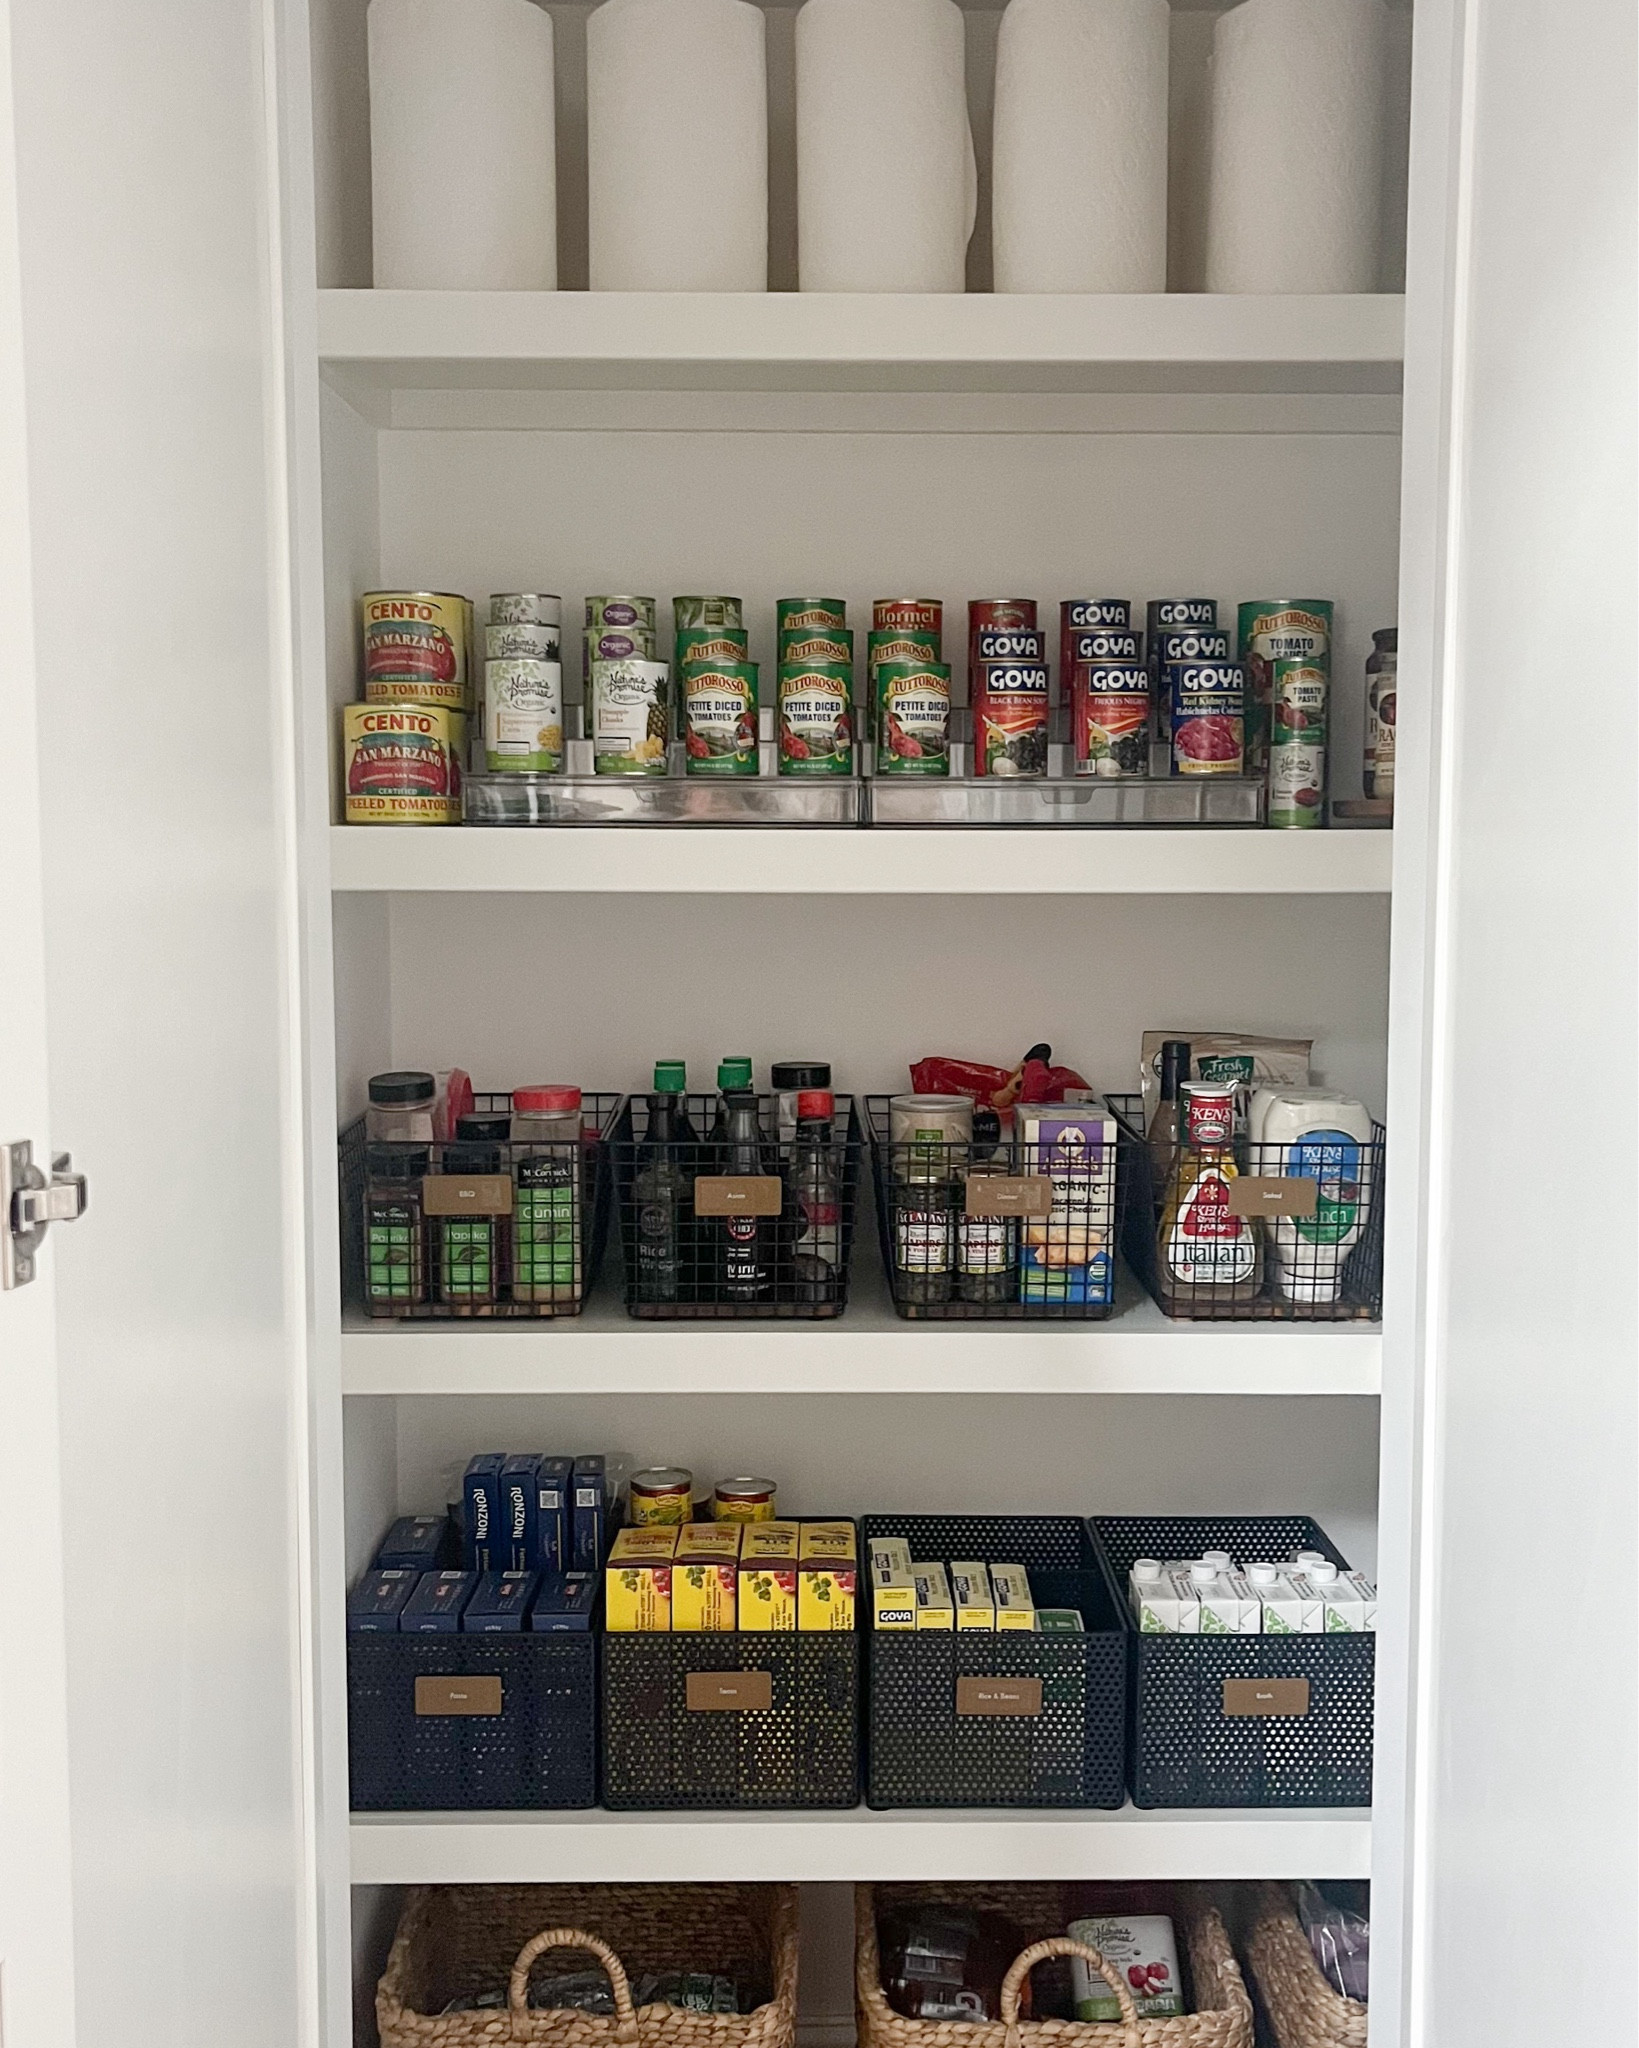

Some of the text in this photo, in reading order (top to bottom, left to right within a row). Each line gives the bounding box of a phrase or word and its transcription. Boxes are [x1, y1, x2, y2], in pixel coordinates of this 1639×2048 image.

[371, 602, 432, 620] CENTO
[878, 608, 934, 623] Hormel
[1072, 606, 1126, 625] GOYA
[1160, 604, 1213, 623] GOYA
[383, 633, 445, 654] MARZANO
[601, 641, 631, 651] Organic
[875, 643, 932, 659] TUTTOROSSO
[982, 637, 1038, 656] GOYA
[1080, 638, 1136, 657] GOYA
[1168, 637, 1226, 658] GOYA
[1269, 638, 1314, 649] TOMATO
[511, 674, 550, 689] Nature's
[610, 671, 647, 685] Nature's
[784, 676, 843, 694] TUTTOROSSO
[990, 669, 1046, 690] GOYA
[1092, 670, 1148, 690] GOYA
[1183, 668, 1243, 690] GOYA
[391, 684, 455, 697] TOMATOES
[508, 686, 554, 701] Promise
[1293, 687, 1321, 695] TOMATO
[688, 701, 742, 712] PETITE DICED
[895, 701, 925, 711] PETITE
[990, 696, 1012, 704] BLACK
[1297, 695, 1318, 703] PASTE
[785, 702, 841, 712] PETITE DICED
[363, 714, 431, 732] CENTO
[694, 713, 732, 722] TOMATOES
[793, 713, 832, 722] TOMATOES
[905, 713, 942, 722] TOMATOES
[356, 746, 442, 767] SAN MARZANO
[1209, 1059, 1243, 1073] Fresh
[1203, 1068, 1250, 1081] Gourmet
[1192, 1107, 1232, 1123] KEN'S
[523, 1168, 569, 1177] MCormick
[523, 1207, 570, 1219] Cumin
[447, 1231, 488, 1241] Paprka
[473, 1488, 489, 1540] RONZONI
[511, 1487, 526, 1539] RONZONI
[880, 1612, 912, 1622] GOYA
